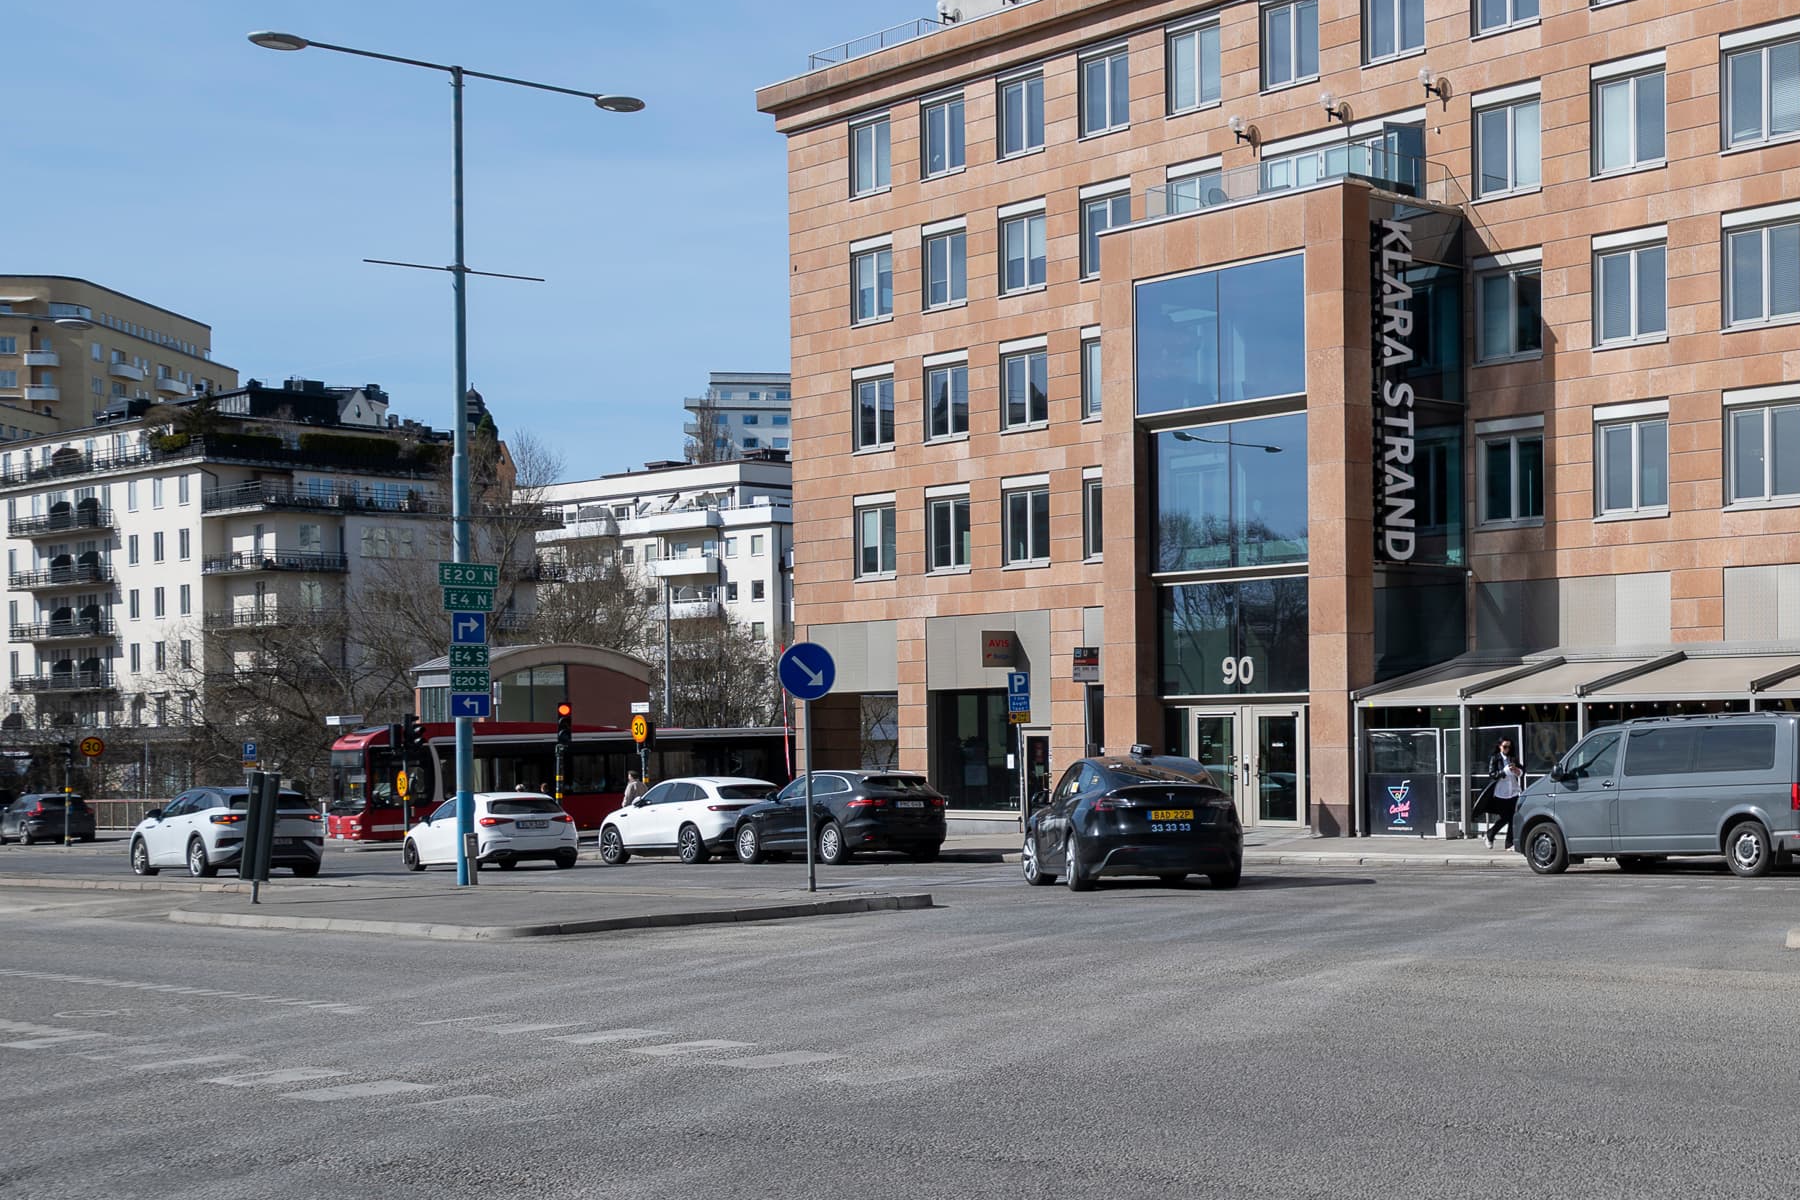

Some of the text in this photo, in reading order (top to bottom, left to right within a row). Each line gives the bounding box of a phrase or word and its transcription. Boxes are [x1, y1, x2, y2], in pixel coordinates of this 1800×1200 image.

[1382, 219, 1416, 561] KLARA STRAND
[443, 569, 493, 581] E20 N
[450, 593, 487, 605] E4 N
[988, 639, 1009, 648] AVIS
[454, 651, 485, 662] E4 S
[1222, 656, 1254, 685] 90
[455, 676, 486, 686] E20 S
[1013, 674, 1025, 692] P
[634, 722, 645, 735] 30
[84, 742, 100, 752] 30
[246, 744, 254, 754] P
[1154, 810, 1190, 819] BAD 22P
[1151, 823, 1191, 832] 33 33 33
